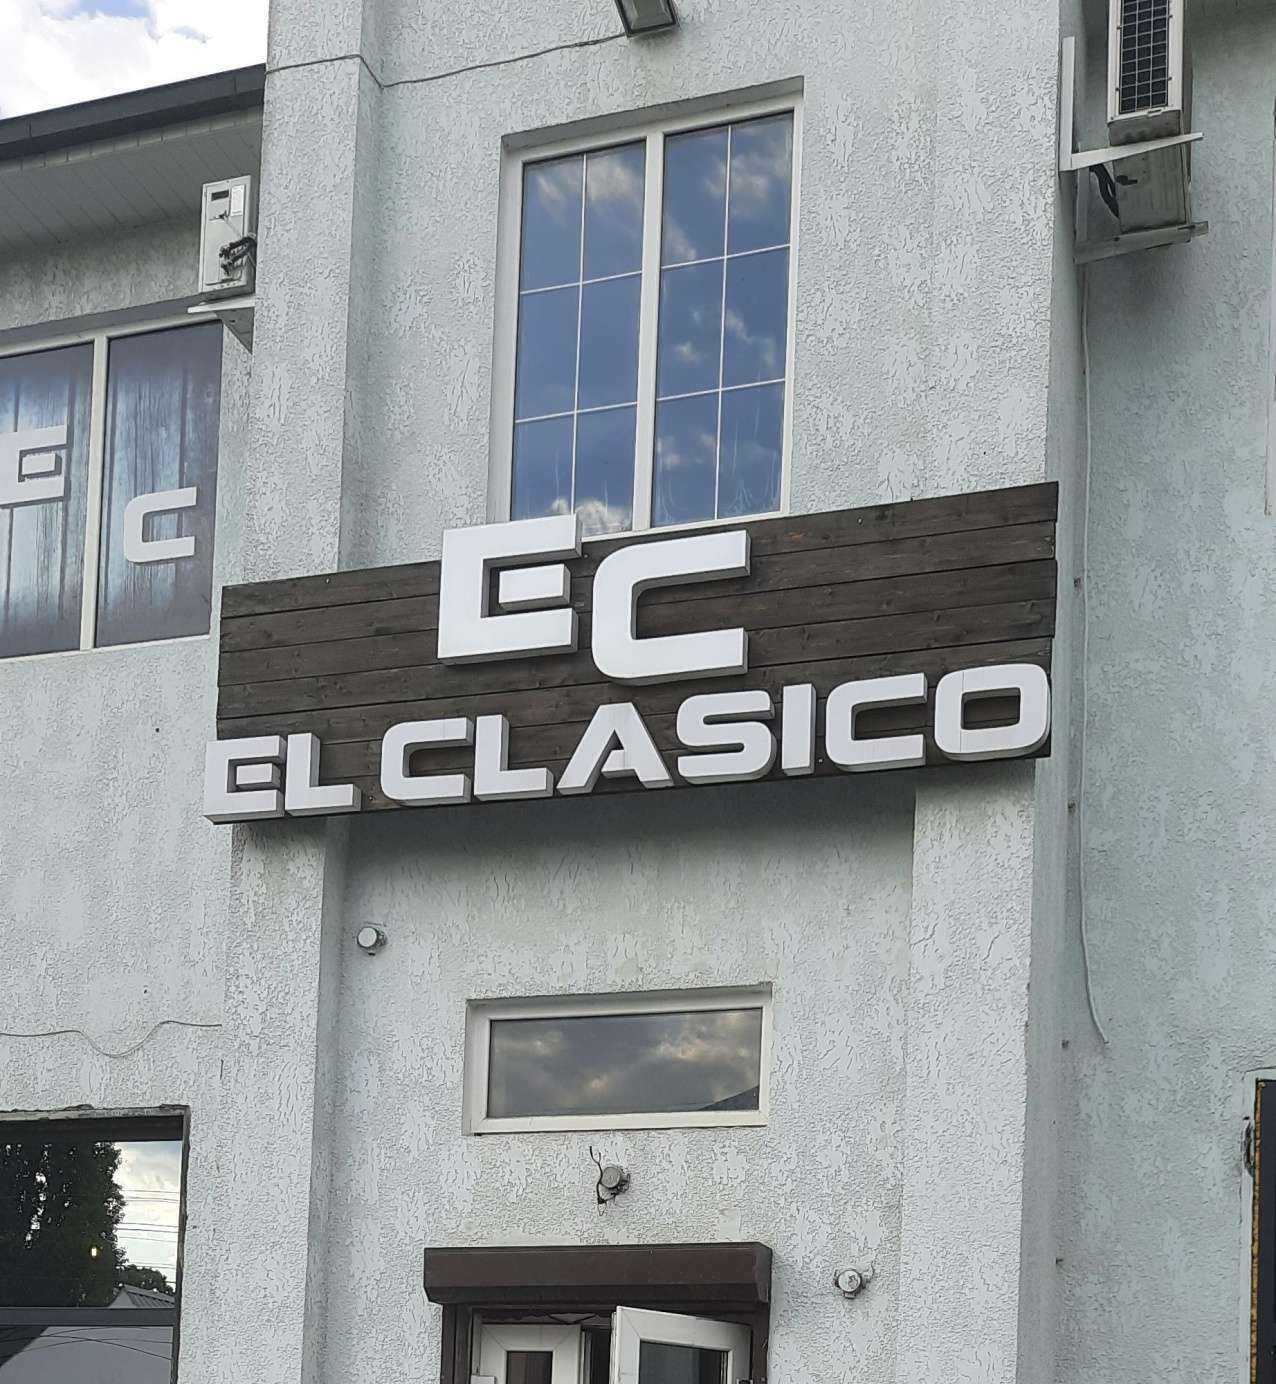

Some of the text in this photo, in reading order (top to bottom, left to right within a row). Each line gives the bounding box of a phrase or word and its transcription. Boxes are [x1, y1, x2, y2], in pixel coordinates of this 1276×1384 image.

[437, 514, 750, 686] EC
[204, 663, 1051, 824] EL CLASICO
